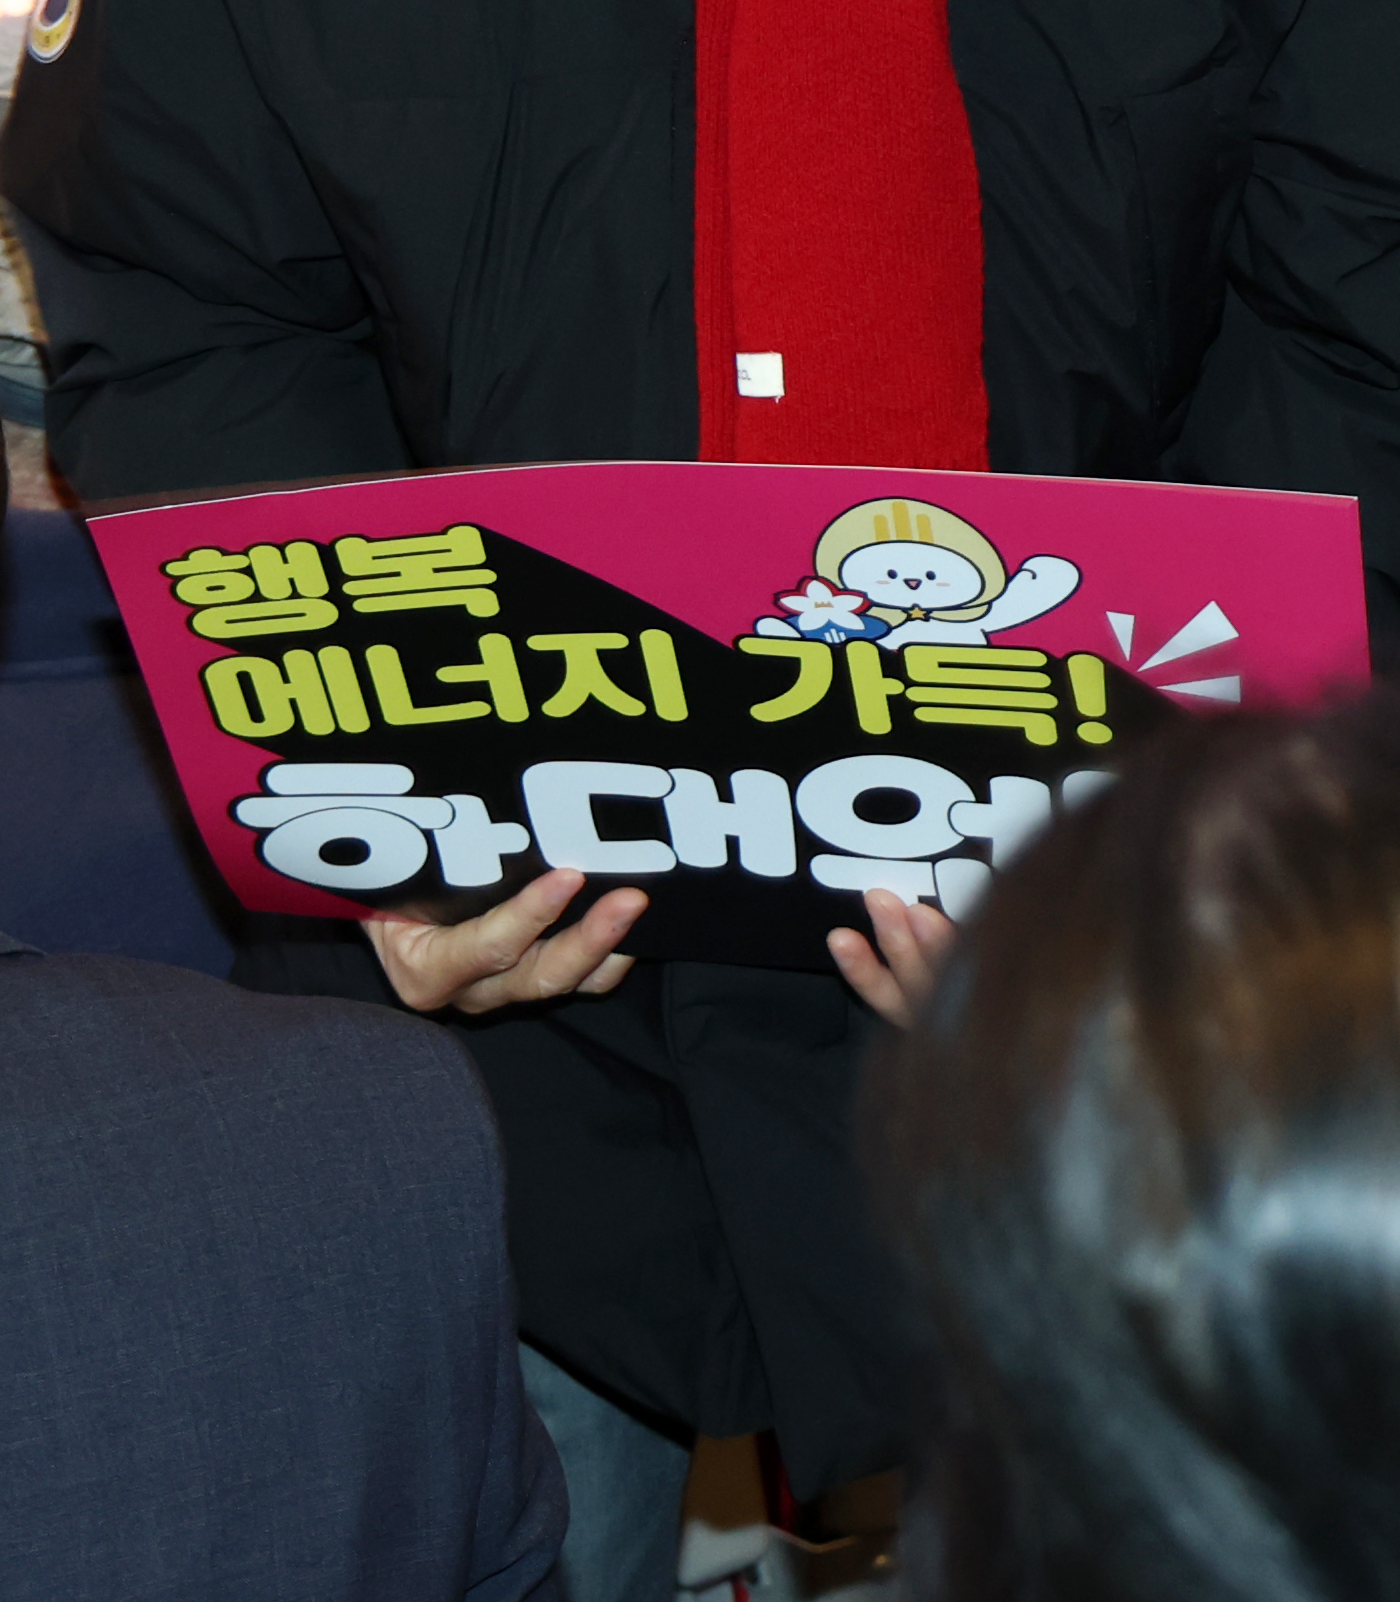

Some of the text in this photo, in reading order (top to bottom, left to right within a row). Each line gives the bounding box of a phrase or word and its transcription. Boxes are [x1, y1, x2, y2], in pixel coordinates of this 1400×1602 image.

[165, 525, 500, 639] 행복
[204, 628, 1113, 746] 에너지 가득!
[235, 754, 1120, 922] 하대원
